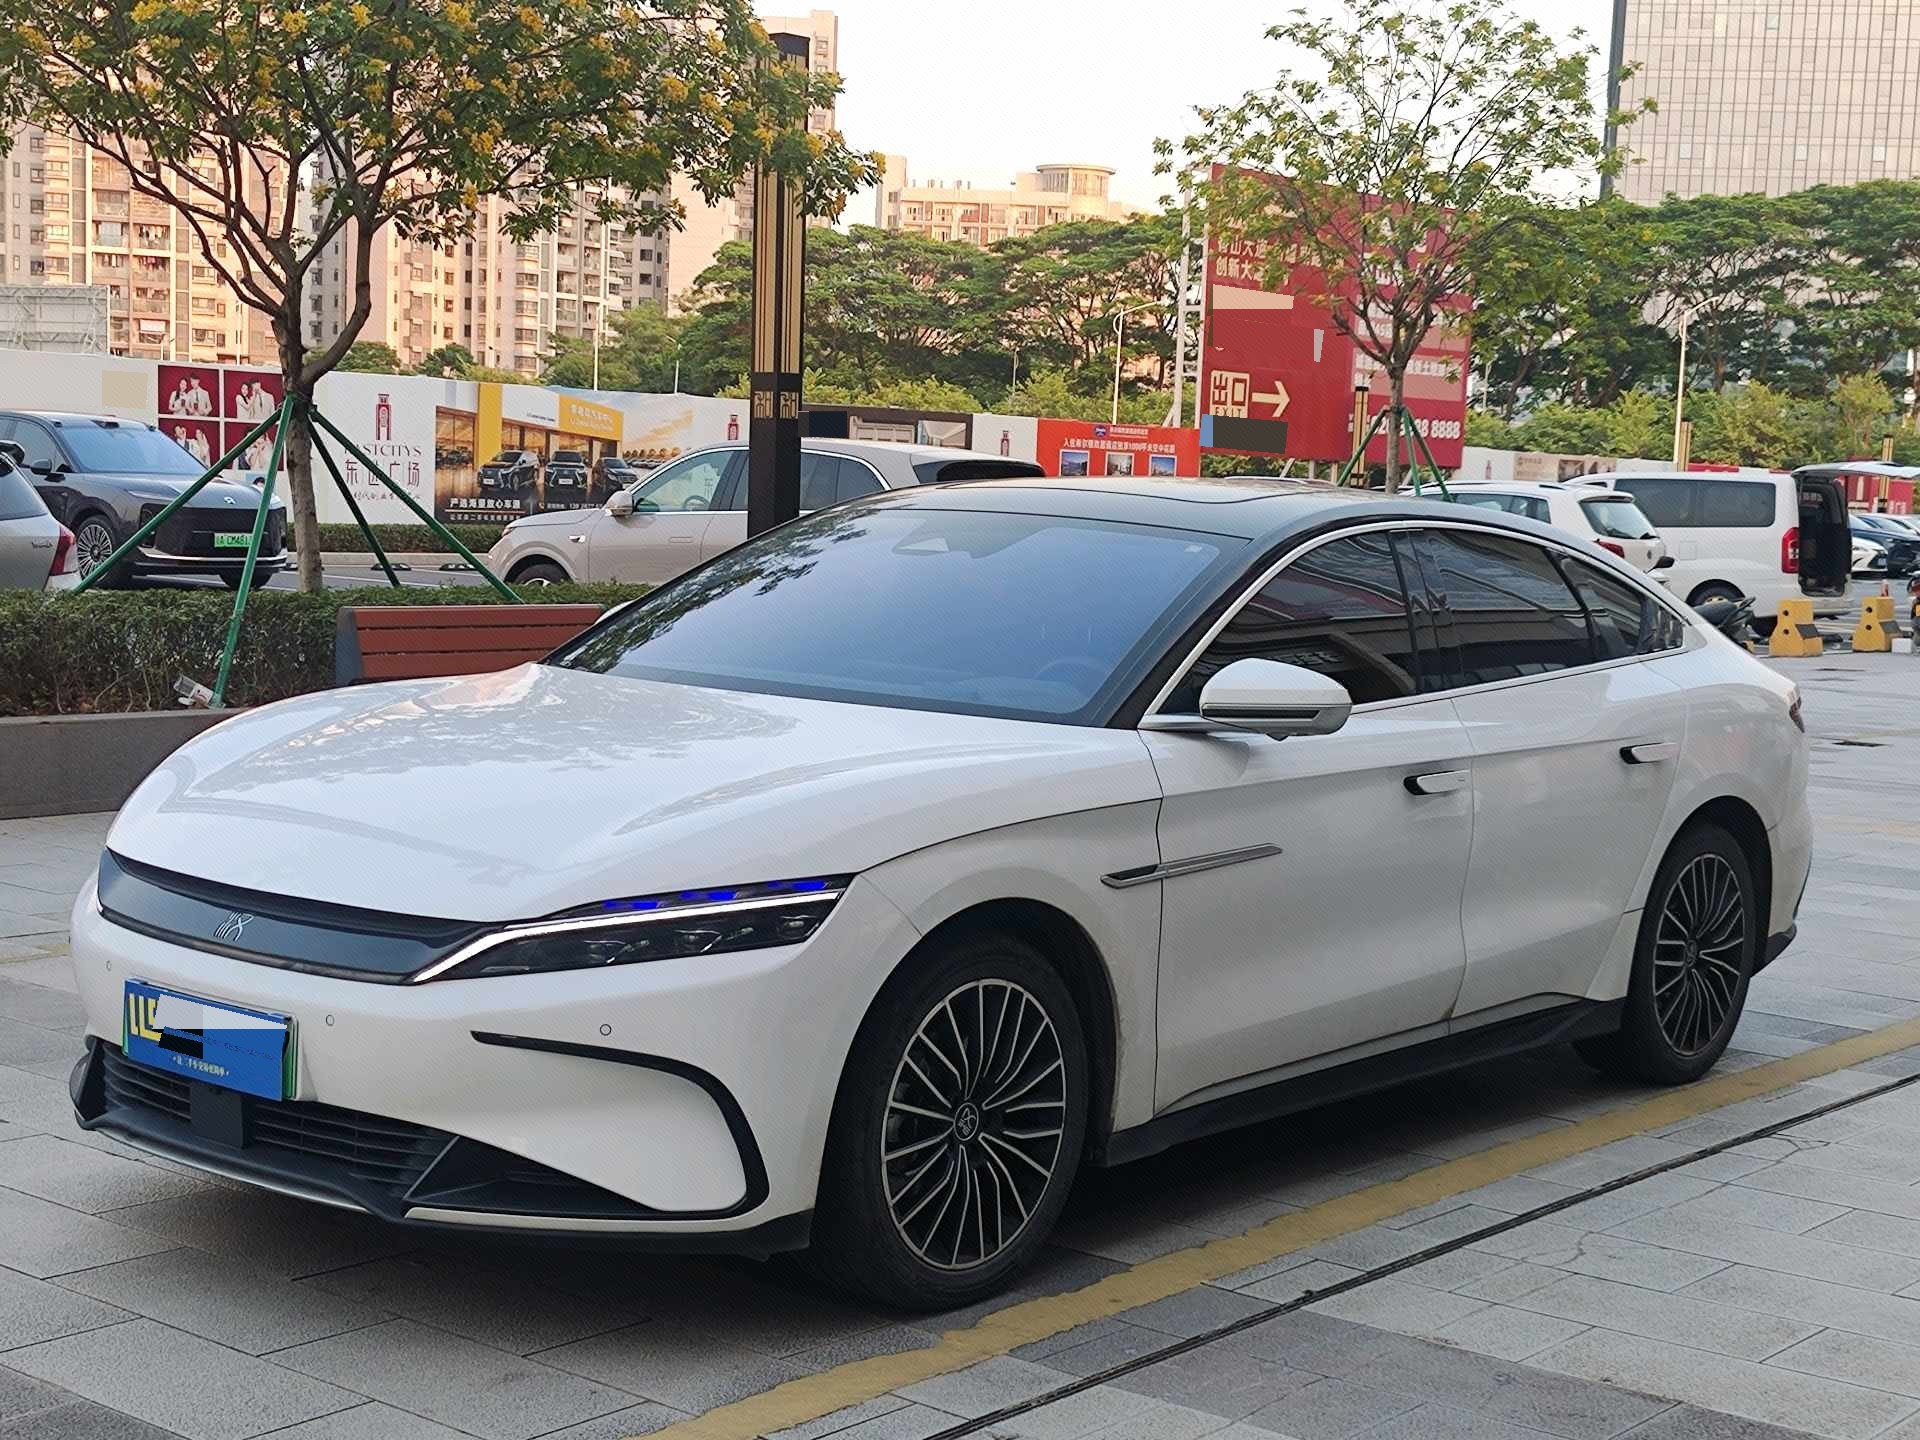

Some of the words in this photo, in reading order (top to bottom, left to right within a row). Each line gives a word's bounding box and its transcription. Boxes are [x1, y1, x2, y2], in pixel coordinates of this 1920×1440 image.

[1212, 374, 1247, 406] 出口
[1215, 407, 1242, 417] EXIT
[1430, 420, 1461, 440] 8888
